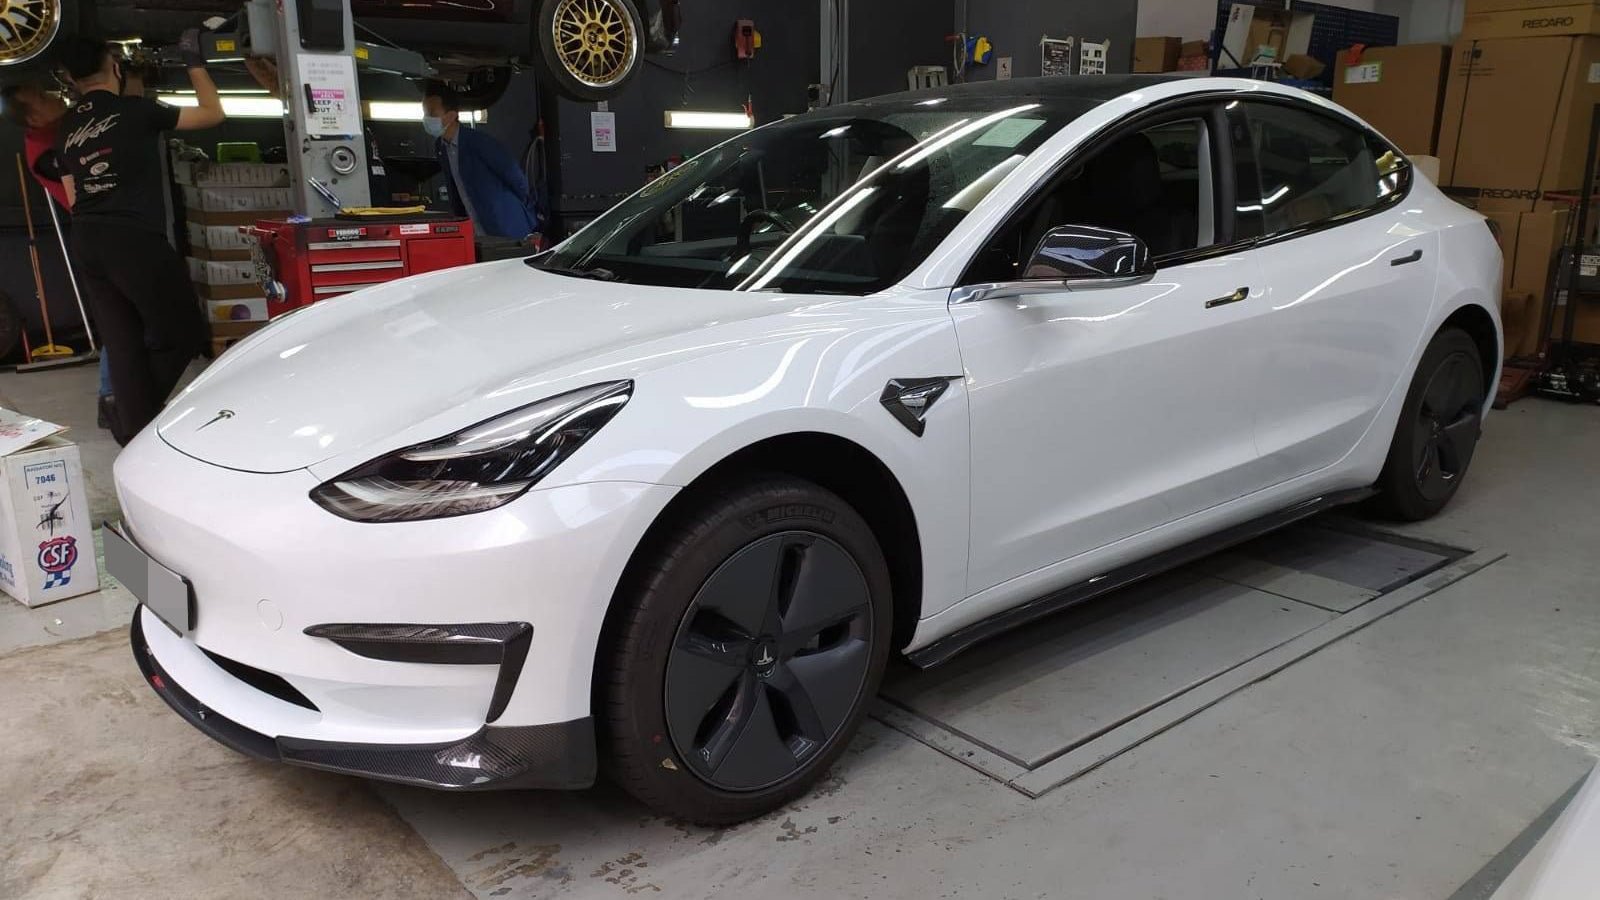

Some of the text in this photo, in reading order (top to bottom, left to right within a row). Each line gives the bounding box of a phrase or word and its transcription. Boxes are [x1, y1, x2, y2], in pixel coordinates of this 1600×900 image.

[1521, 16, 1574, 28] RECARO
[1481, 188, 1542, 200] RECARO
[35, 473, 56, 485] 7046
[767, 504, 835, 523] MICHELIN
[40, 543, 70, 567] CSF
